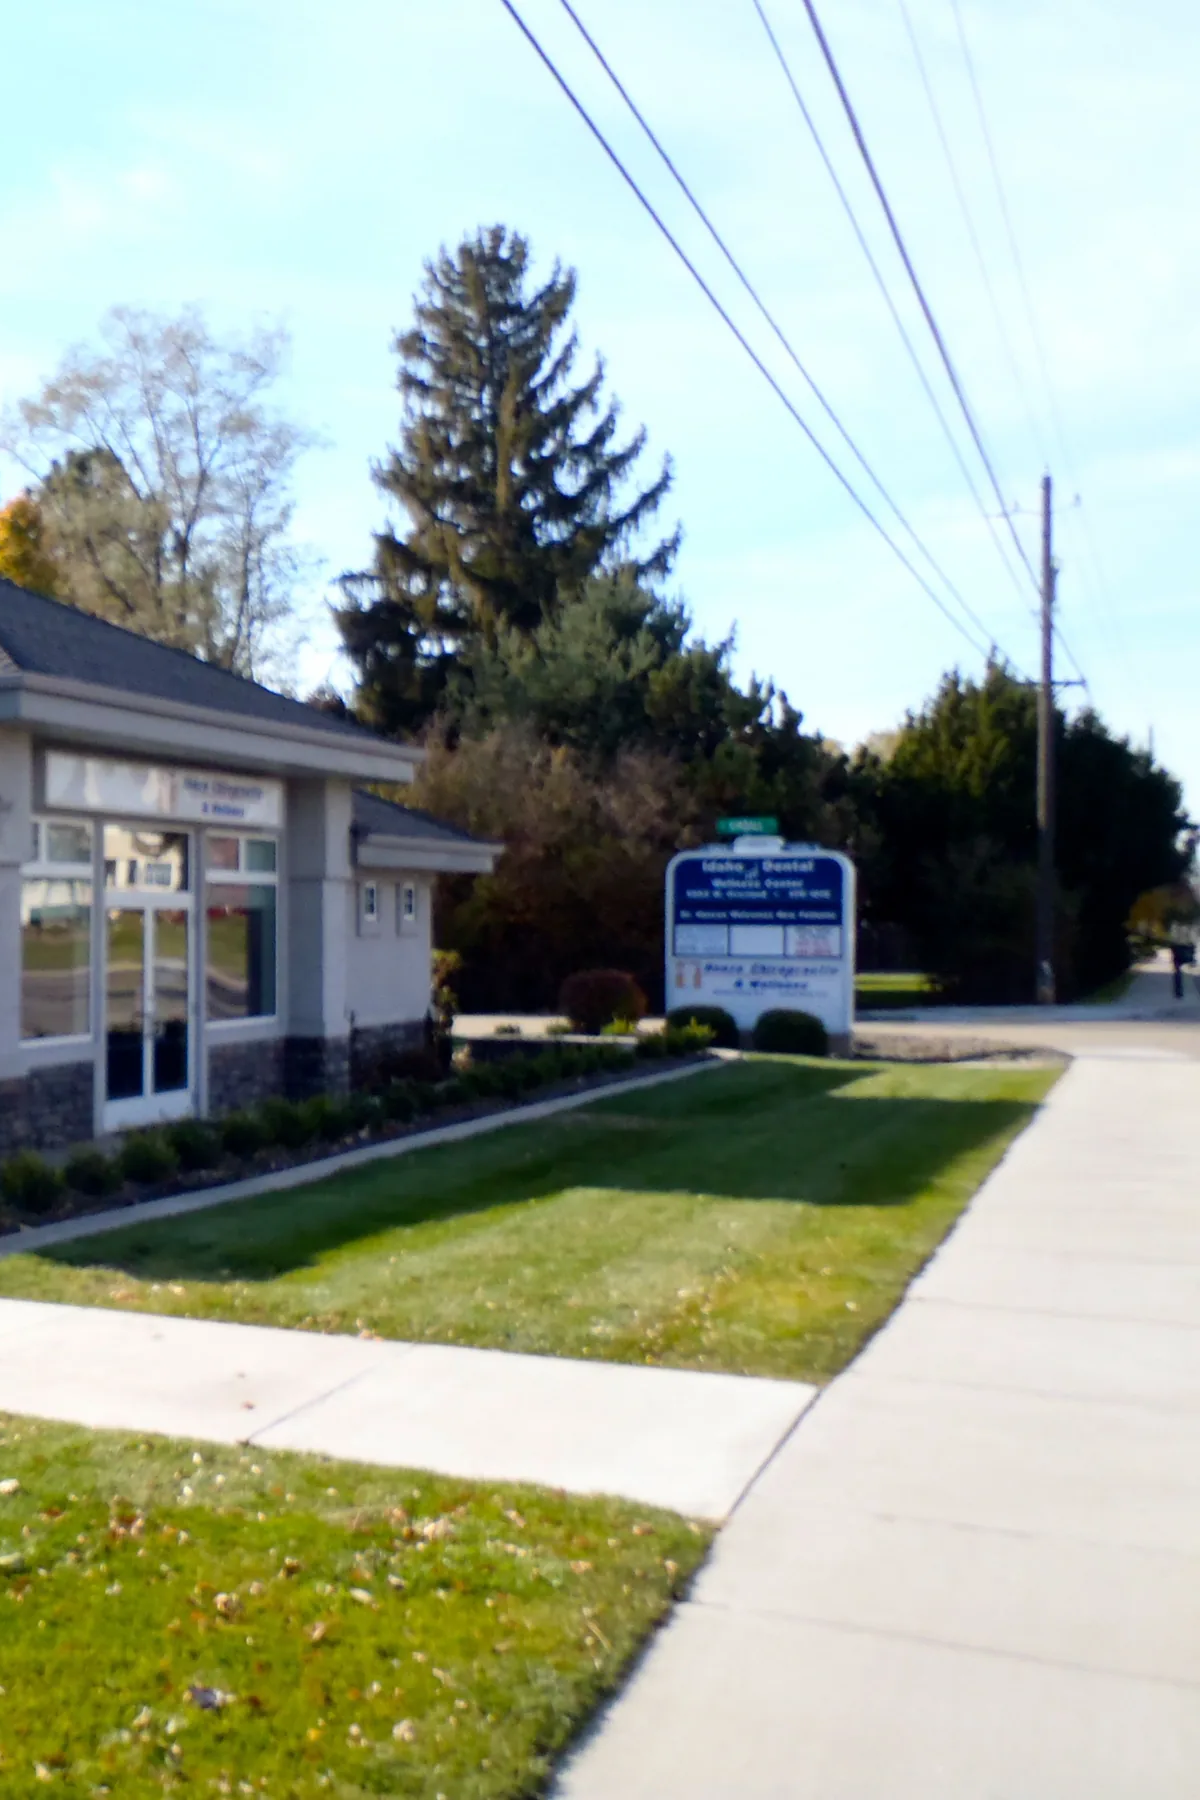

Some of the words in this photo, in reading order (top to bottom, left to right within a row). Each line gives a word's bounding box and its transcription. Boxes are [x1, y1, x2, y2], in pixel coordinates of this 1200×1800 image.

[702, 860, 744, 872] Idaho
[762, 860, 814, 873] Dental
[711, 878, 760, 888] Wellness
[765, 878, 804, 888] Center
